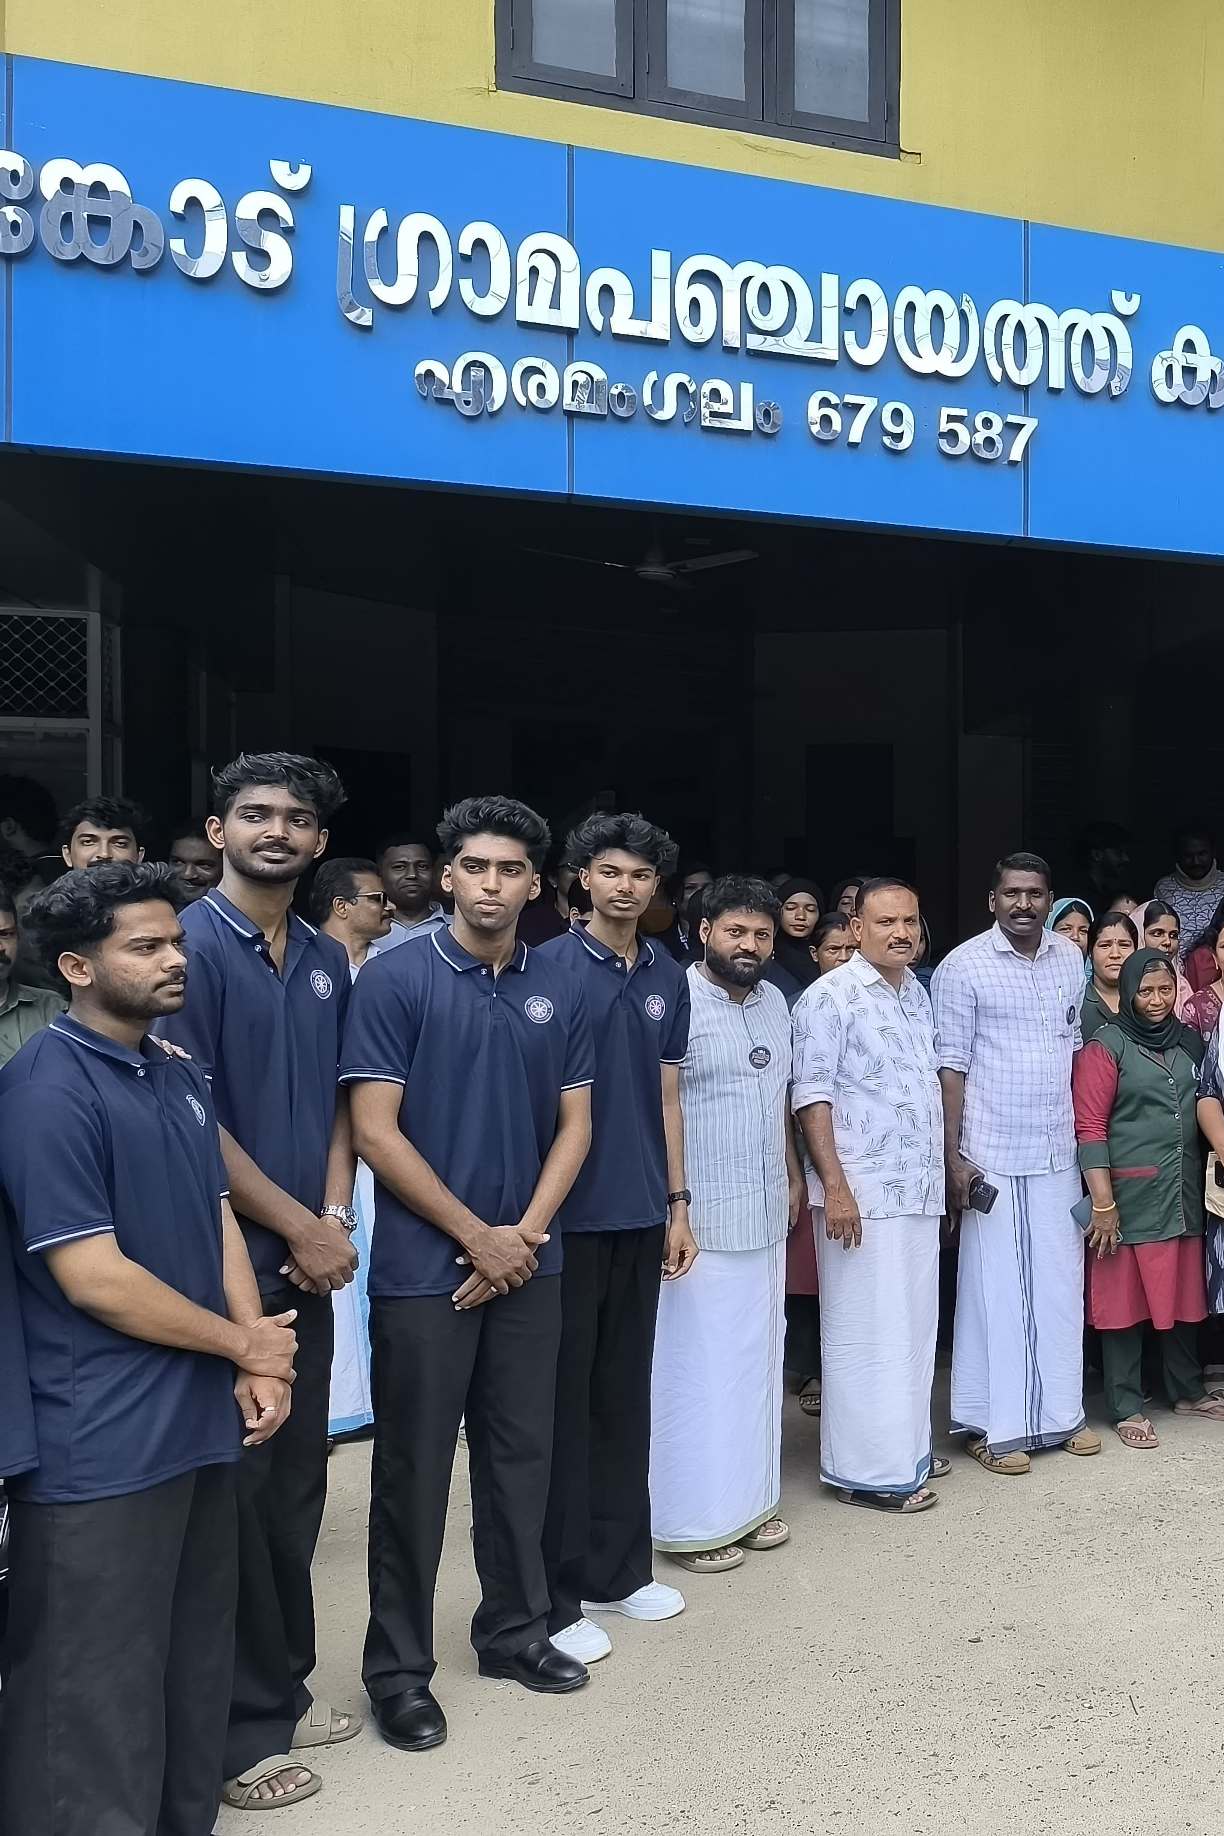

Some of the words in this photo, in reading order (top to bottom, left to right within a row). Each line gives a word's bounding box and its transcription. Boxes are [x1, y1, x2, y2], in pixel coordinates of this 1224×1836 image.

[336, 204, 1141, 398] ഗ്രാമപഞ്ചായത്ത്
[413, 351, 783, 434] എരമംഗലം
[807, 390, 915, 451] 679
[937, 405, 1039, 465] 587
